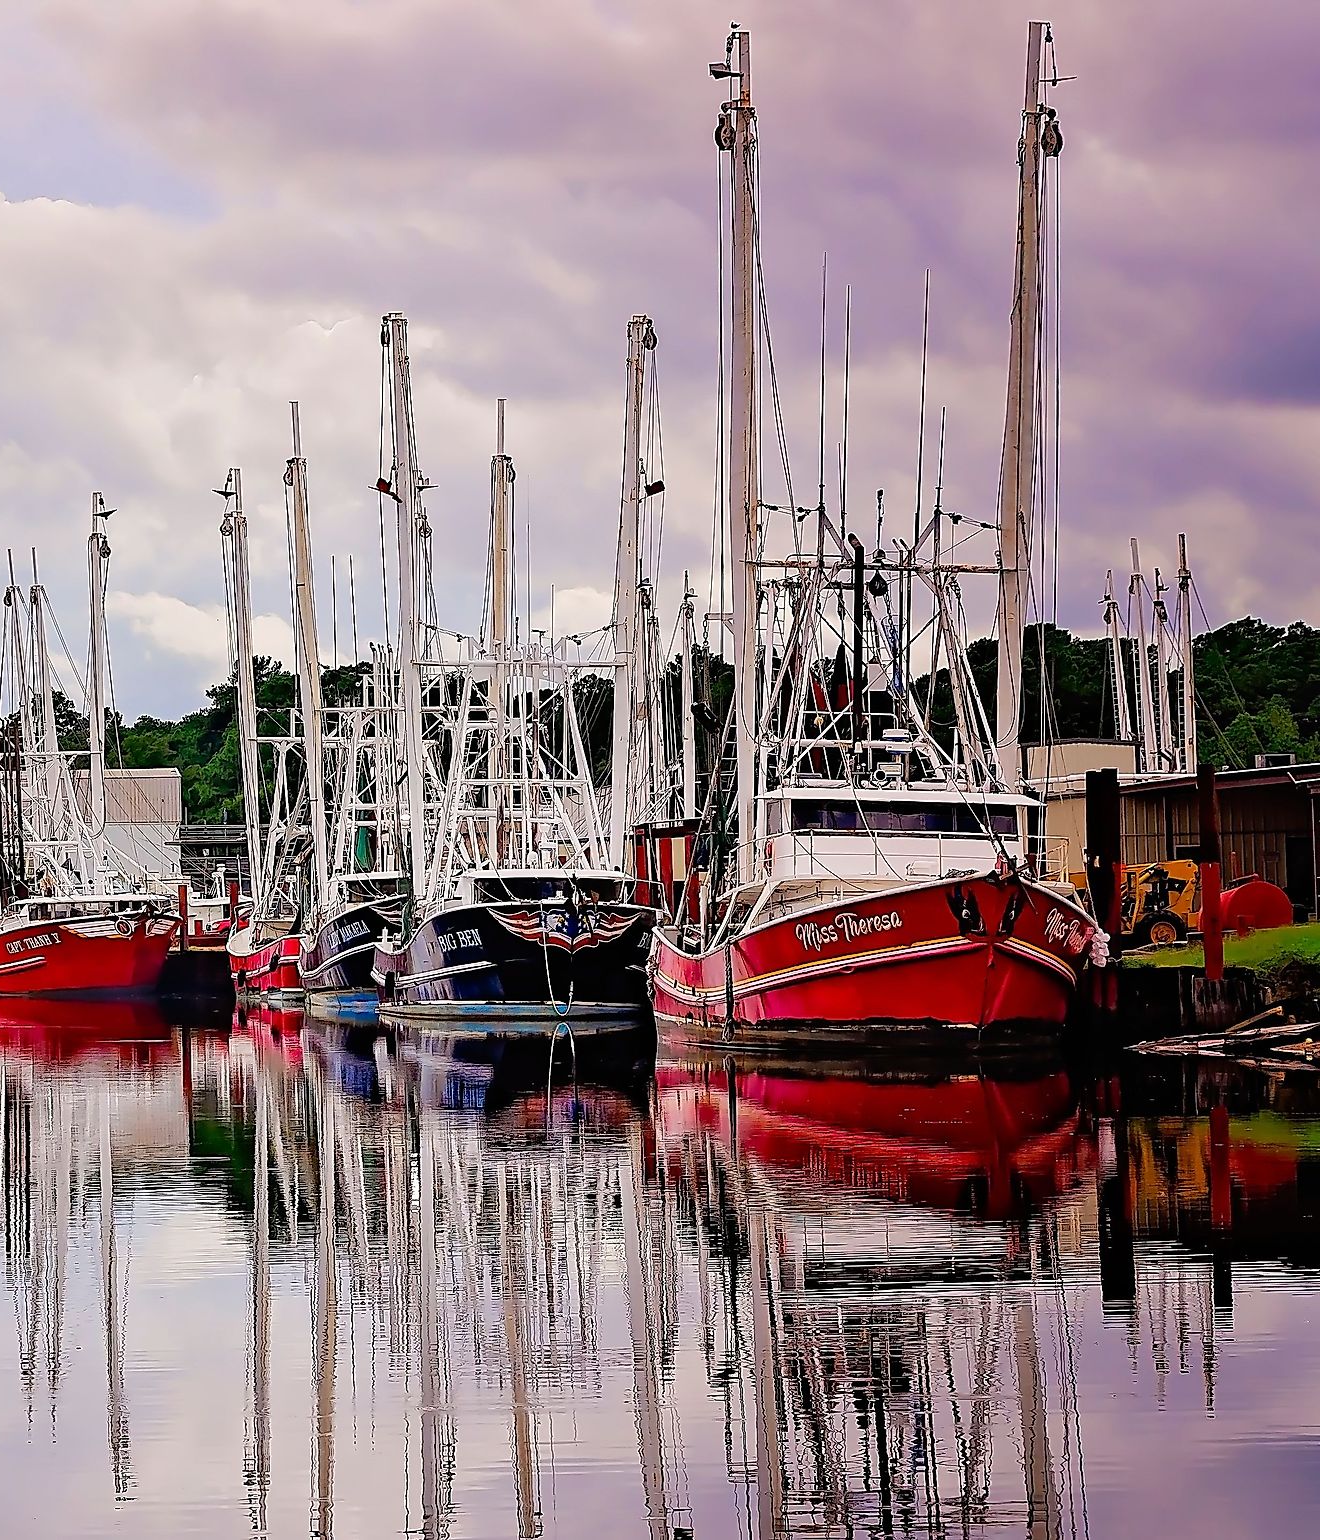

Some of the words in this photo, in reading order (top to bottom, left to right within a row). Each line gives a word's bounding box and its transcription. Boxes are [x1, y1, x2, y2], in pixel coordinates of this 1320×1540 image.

[23, 934, 53, 950] THANH
[437, 933, 458, 953] BIG
[456, 928, 483, 948] BEN
[795, 922, 839, 952] Miss
[834, 911, 903, 943] Theresa
